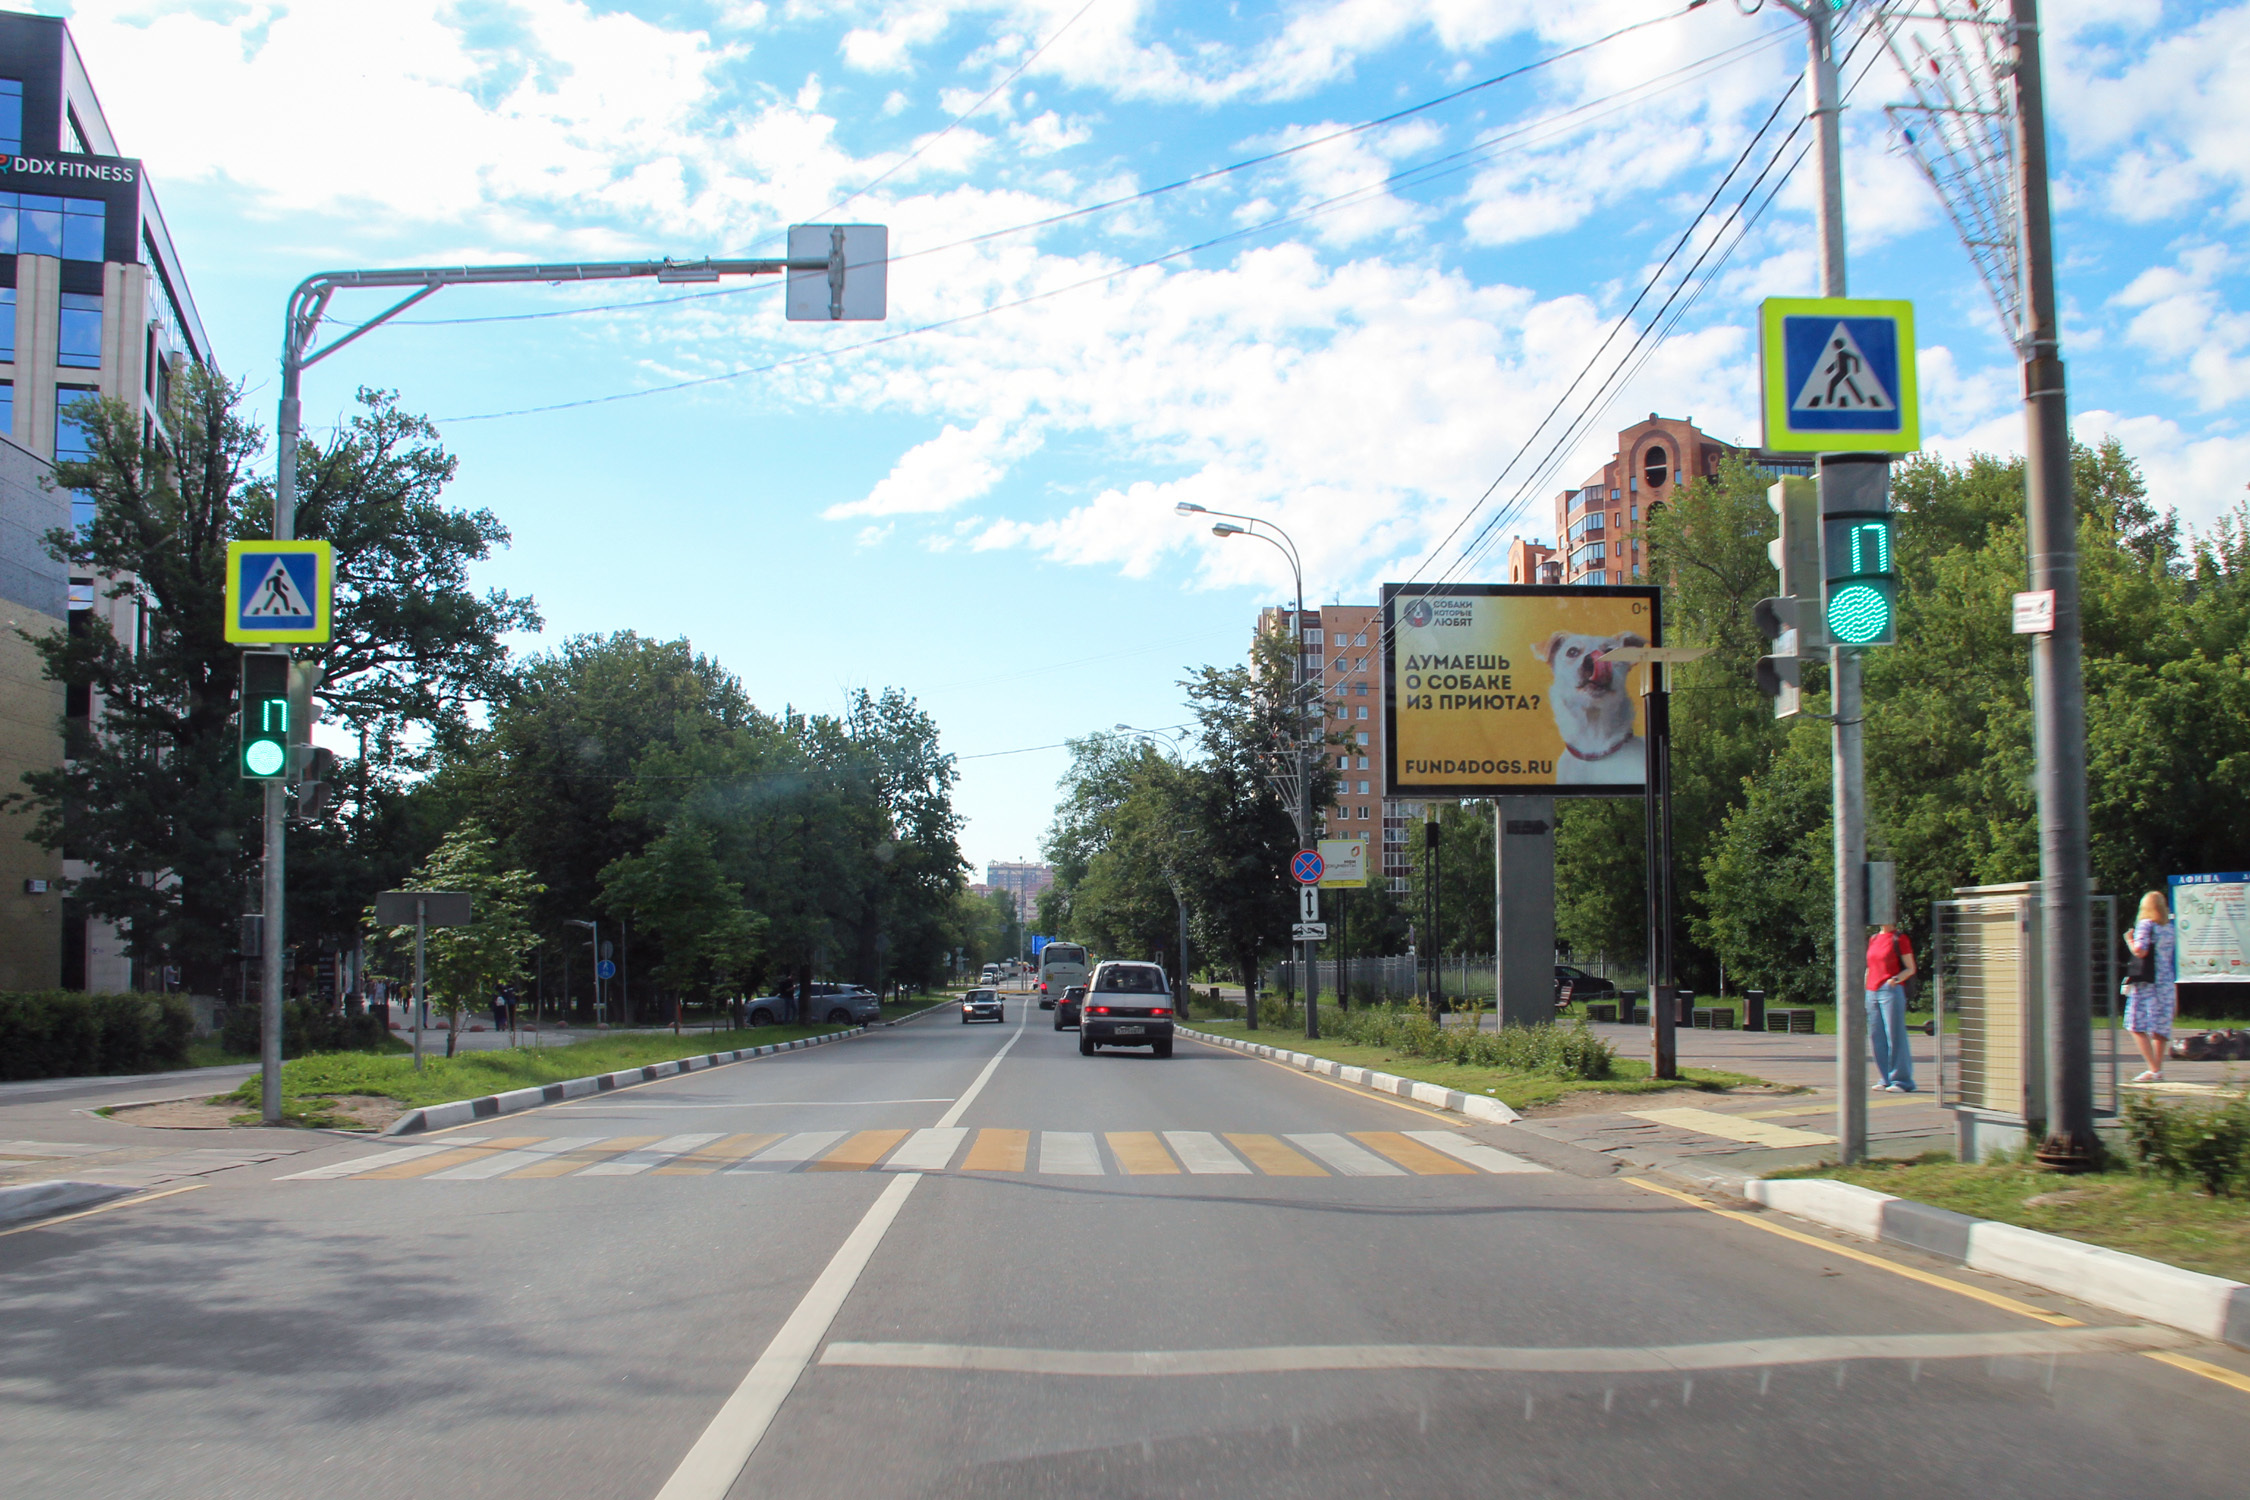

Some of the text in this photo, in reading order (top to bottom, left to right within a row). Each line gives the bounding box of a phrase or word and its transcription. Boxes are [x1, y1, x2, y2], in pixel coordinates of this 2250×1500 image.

[14, 157, 134, 183] DDX FITNESS
[1850, 523, 1888, 573] 17
[1433, 601, 1473, 609] СОБАКИ
[1631, 602, 1649, 615] 0+
[1434, 618, 1473, 627] ЛЮБЯТ
[1405, 655, 1510, 671] ДУМАЕШЬ
[1406, 675, 1512, 690] О СОБАКЕ
[1407, 695, 1541, 710] ИЗ ПРИЮТА?
[263, 699, 288, 732] 17
[1405, 760, 1553, 774] FUND4DOGS.RU
[2178, 874, 2220, 884] АФИША
